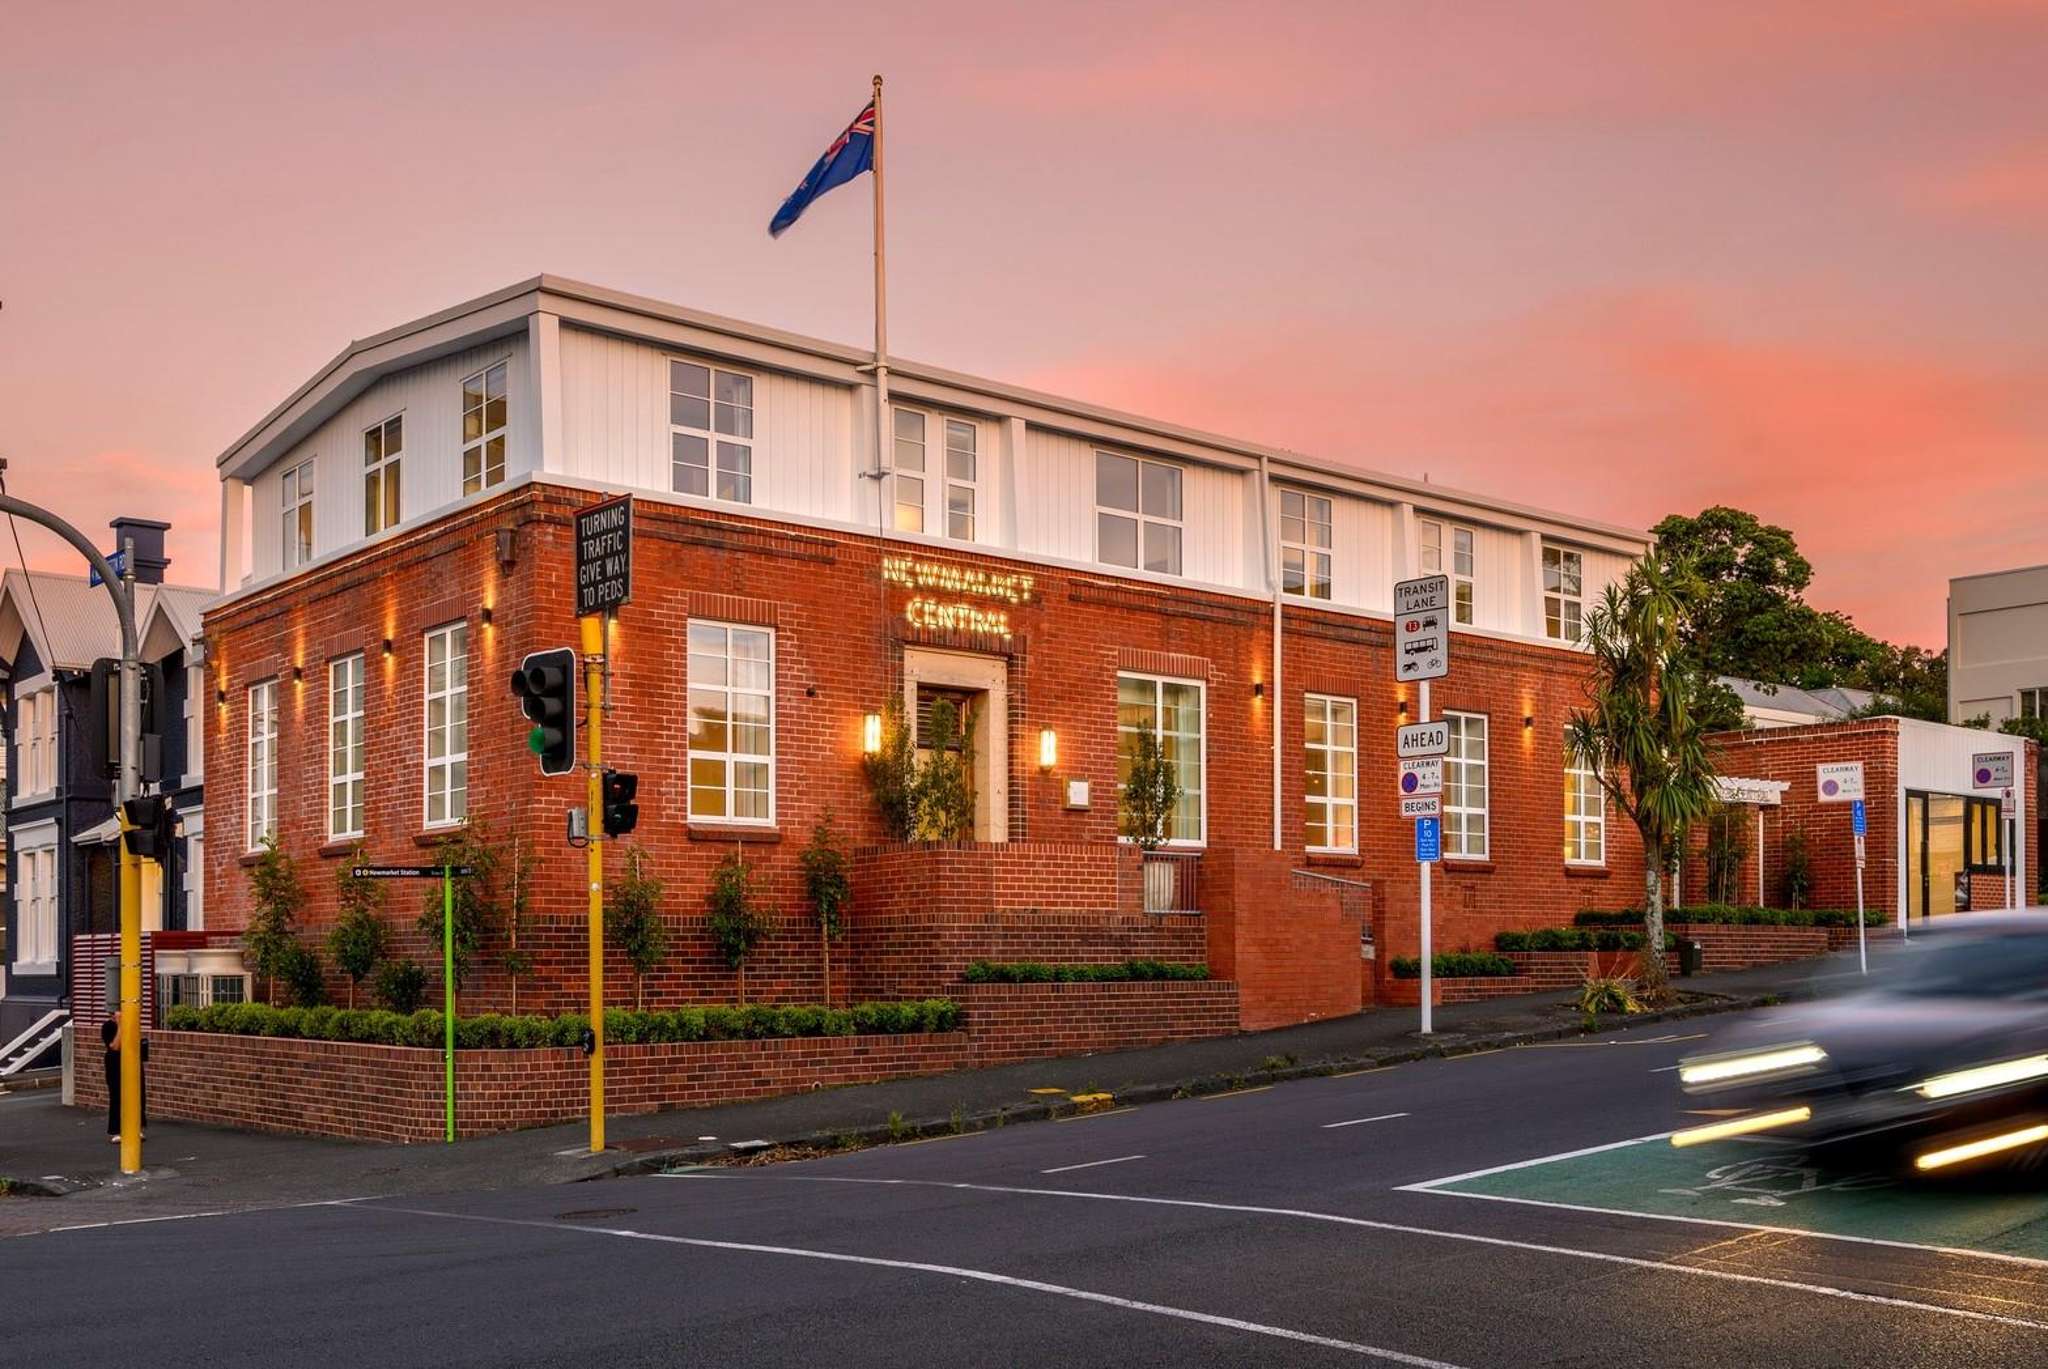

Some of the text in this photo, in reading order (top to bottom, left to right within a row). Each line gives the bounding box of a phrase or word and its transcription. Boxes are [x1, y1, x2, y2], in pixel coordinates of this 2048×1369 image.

[581, 506, 625, 536] TURNING
[583, 531, 623, 560] TRAFFIC
[580, 552, 627, 585] GIVE WAY
[882, 556, 1034, 604] NEWMARKET
[1398, 580, 1445, 598] TRANSIT
[583, 578, 624, 607] TO PEDS
[1406, 596, 1437, 611] LANE
[906, 596, 1012, 640] CENTRAL
[1402, 730, 1444, 750] AHEAD
[1402, 760, 1440, 770] CLEARWAY
[1976, 755, 2010, 763] CLEARWAY
[1822, 766, 1859, 774] CLEARWAY
[1404, 800, 1437, 812] BEGINS
[1423, 820, 1432, 830] P
